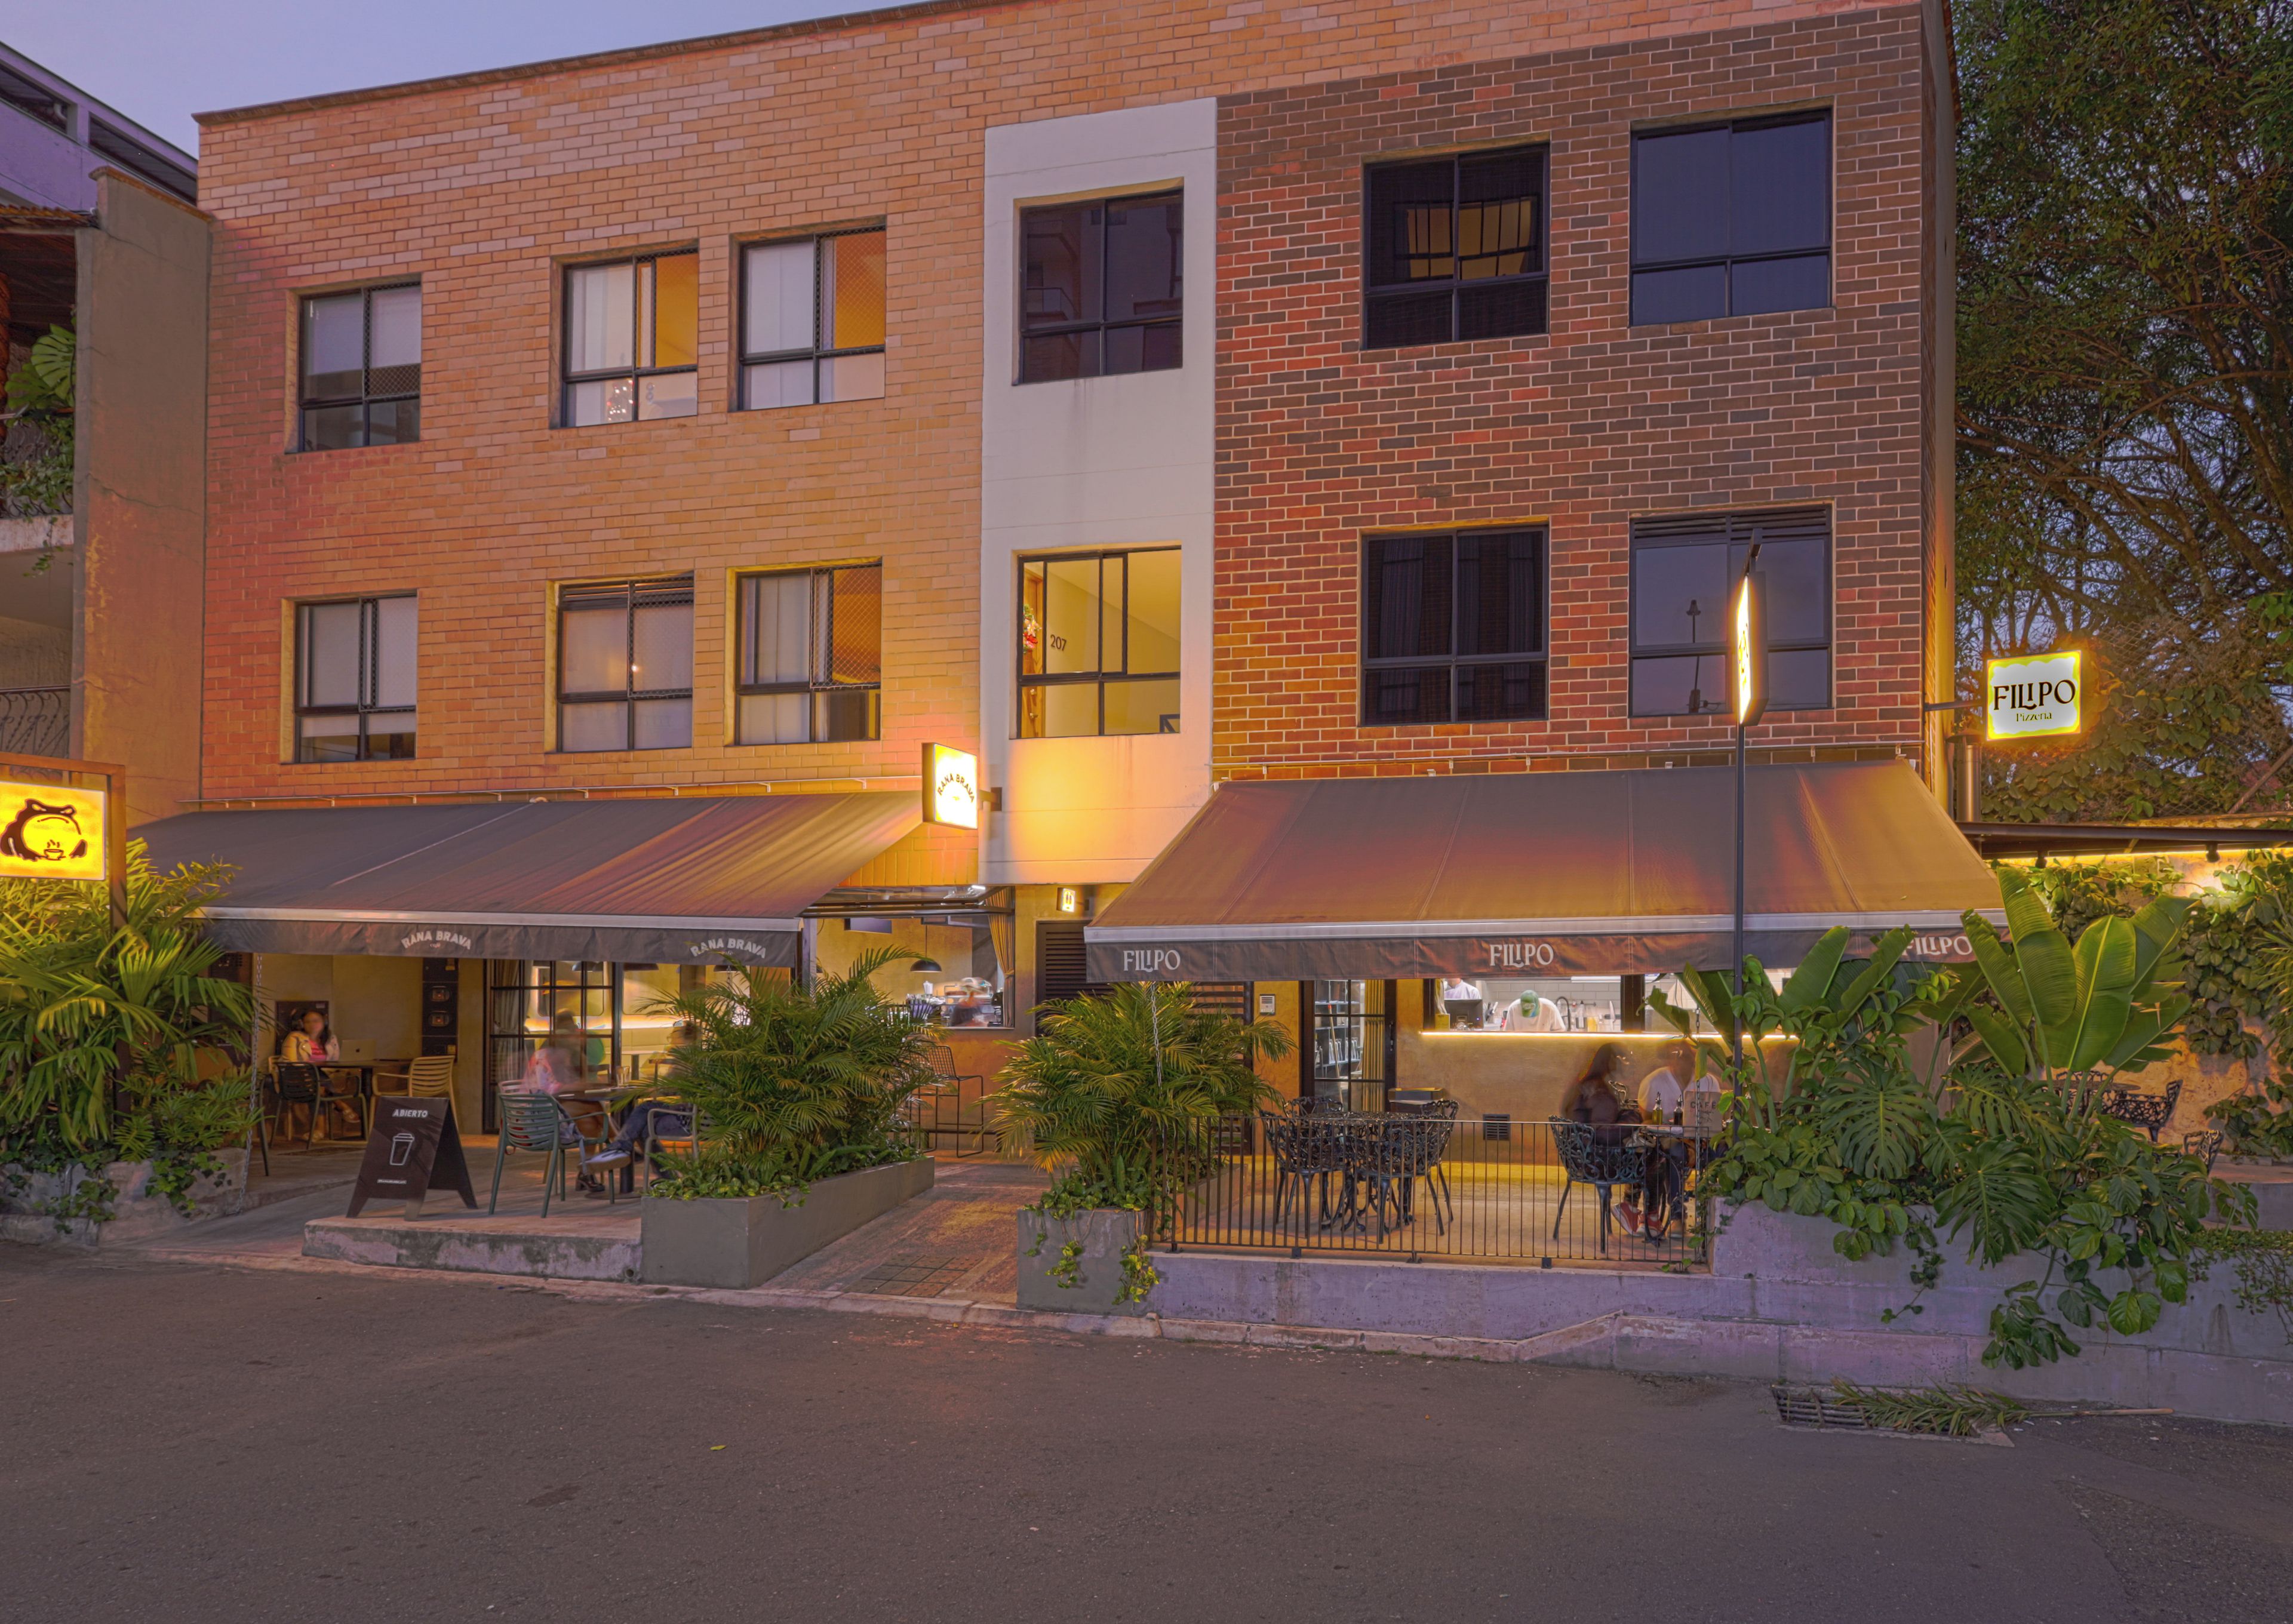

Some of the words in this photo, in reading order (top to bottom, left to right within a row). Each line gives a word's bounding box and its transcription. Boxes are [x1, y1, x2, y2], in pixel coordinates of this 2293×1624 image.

[1050, 634, 1066, 651] 207
[1993, 679, 2076, 710] FILIPO
[2016, 712, 2052, 722] Pizzeria
[938, 773, 954, 796] RANA
[956, 774, 975, 803] BRAVA
[401, 931, 432, 948] RANA
[435, 931, 471, 950] BRAVA
[690, 938, 724, 956] RANA
[727, 938, 766, 958] BRAVA
[1123, 950, 1181, 973] FILIPO
[1489, 943, 1554, 968] FILIPO
[392, 1109, 428, 1118] ABIERTO
